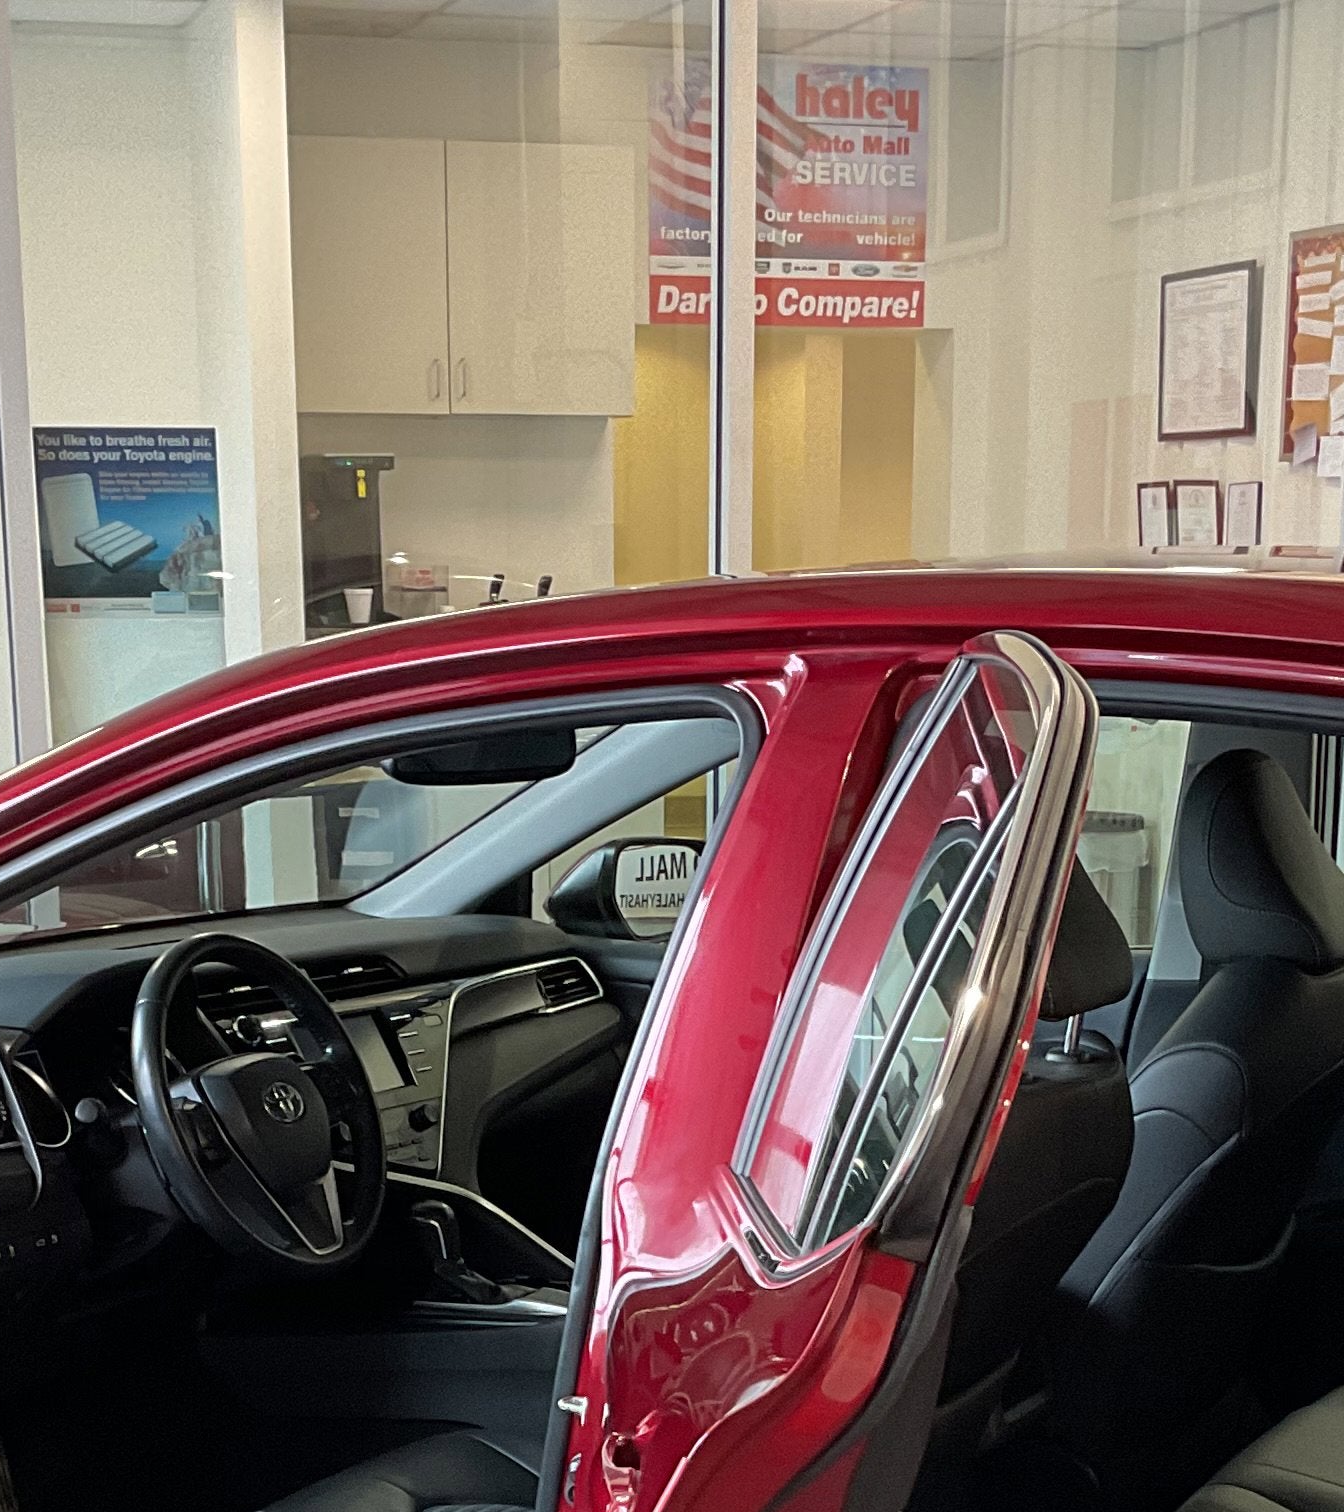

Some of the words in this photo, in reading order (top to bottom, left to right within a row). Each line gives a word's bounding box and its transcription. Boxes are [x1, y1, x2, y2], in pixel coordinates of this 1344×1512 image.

[795, 73, 920, 133] haley
[862, 135, 910, 156] Mall
[794, 160, 917, 187] SERVICE
[764, 208, 793, 222] Our
[798, 208, 887, 225] technicians
[892, 215, 916, 225] are
[781, 229, 804, 243] for
[856, 231, 915, 246] vehicle!
[657, 285, 712, 315] Dar
[754, 293, 768, 316] o
[777, 287, 920, 323] Compare!
[36, 434, 61, 447] You
[63, 434, 87, 447] like
[89, 435, 104, 447] to
[106, 434, 156, 447] breathe
[158, 434, 190, 447] fresh
[193, 435, 212, 447] air.
[38, 449, 56, 461] So
[58, 449, 90, 461] does
[92, 451, 121, 464] your
[123, 449, 167, 464] Toyota
[169, 449, 215, 464] engine.
